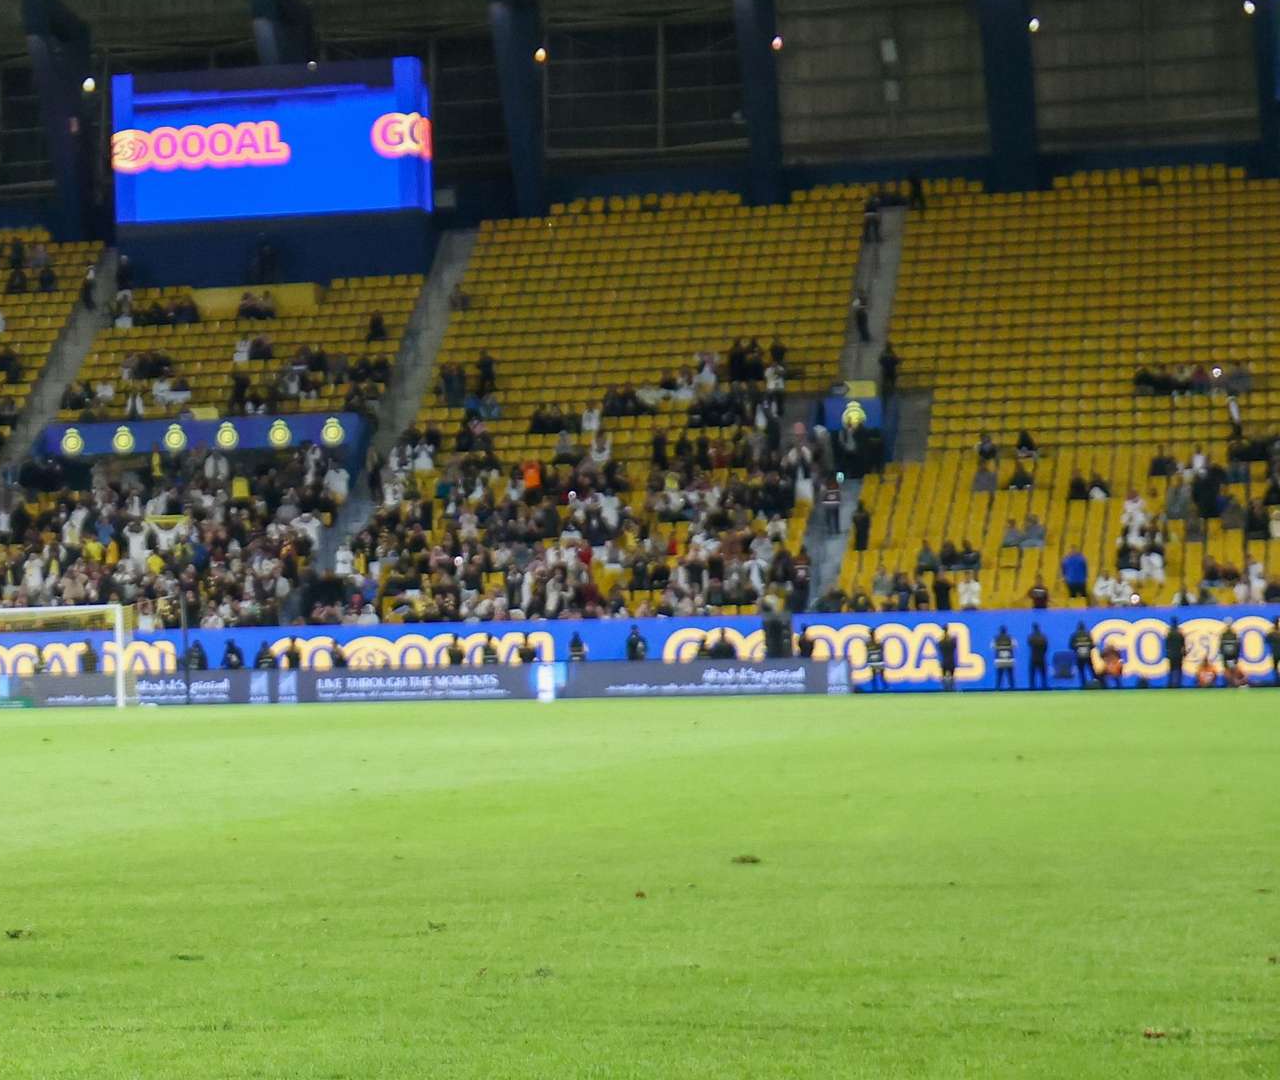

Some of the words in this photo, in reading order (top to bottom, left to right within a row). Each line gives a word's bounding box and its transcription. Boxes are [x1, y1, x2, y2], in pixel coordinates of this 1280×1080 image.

[316, 677, 342, 690] LIVE
[346, 676, 408, 690] THROUGH
[409, 676, 433, 688] THE
[434, 673, 499, 688] MOMENTS
